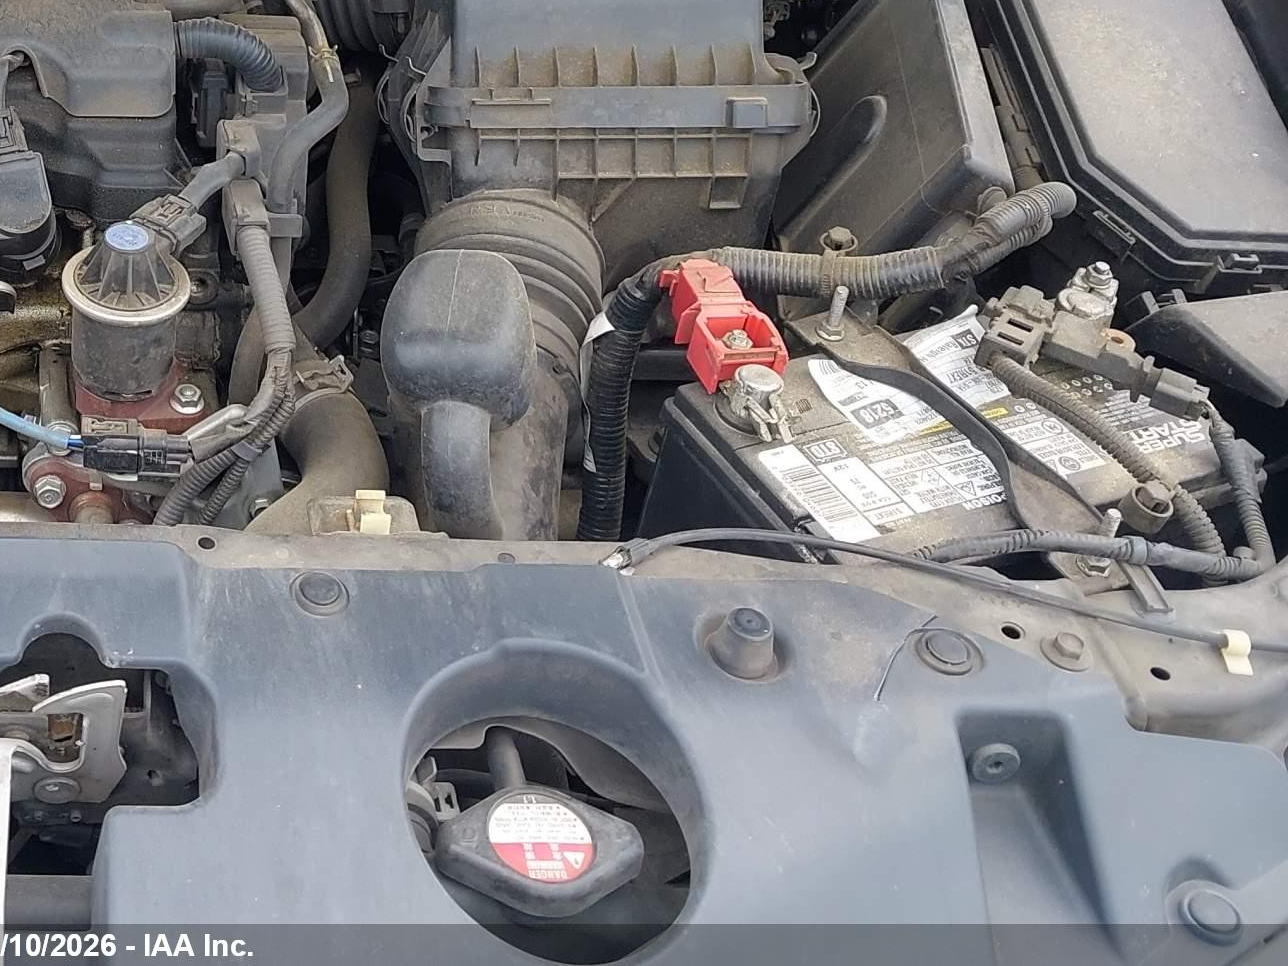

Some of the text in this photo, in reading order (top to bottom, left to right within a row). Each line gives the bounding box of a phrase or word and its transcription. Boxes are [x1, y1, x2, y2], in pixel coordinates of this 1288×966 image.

[859, 402, 895, 424] 5218
[1125, 418, 1203, 445] START
[1137, 432, 1206, 454] SUPER
